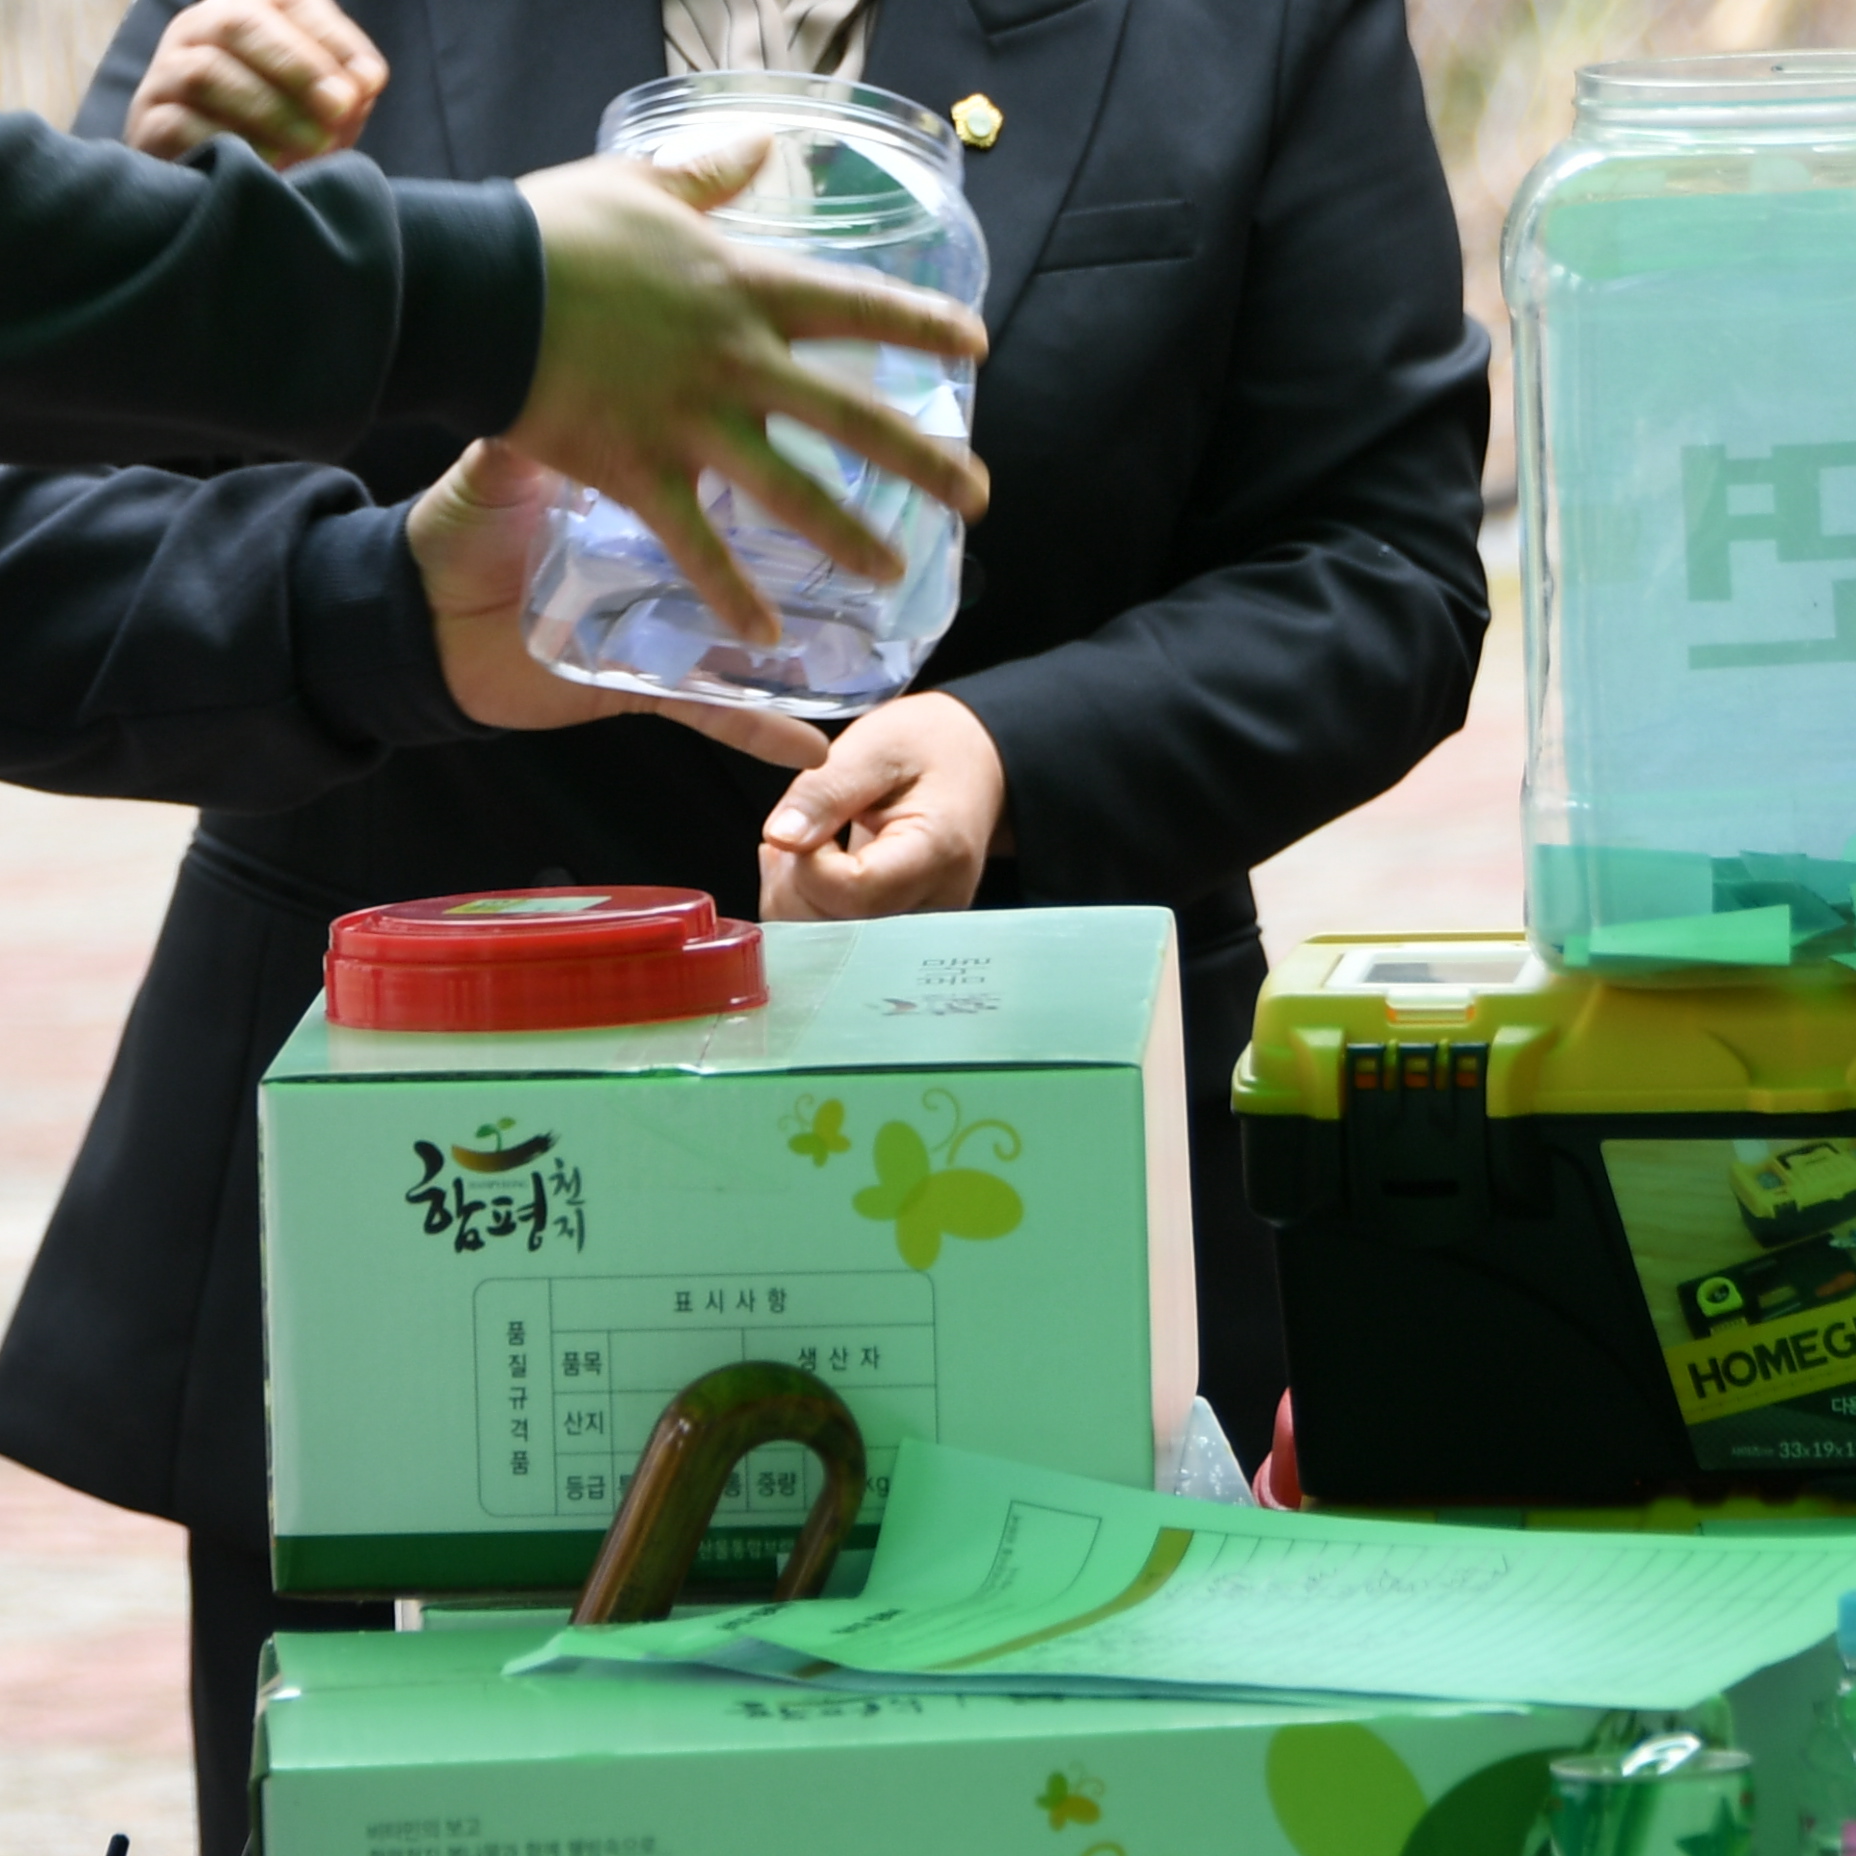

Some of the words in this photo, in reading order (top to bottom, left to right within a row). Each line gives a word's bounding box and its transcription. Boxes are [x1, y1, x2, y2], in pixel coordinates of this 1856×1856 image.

[404, 1139, 548, 1254] 함평
[561, 1350, 603, 1376] 품목
[563, 1410, 604, 1436] 산지
[565, 1471, 606, 1500] 등급
[756, 1470, 798, 1499] 중량
